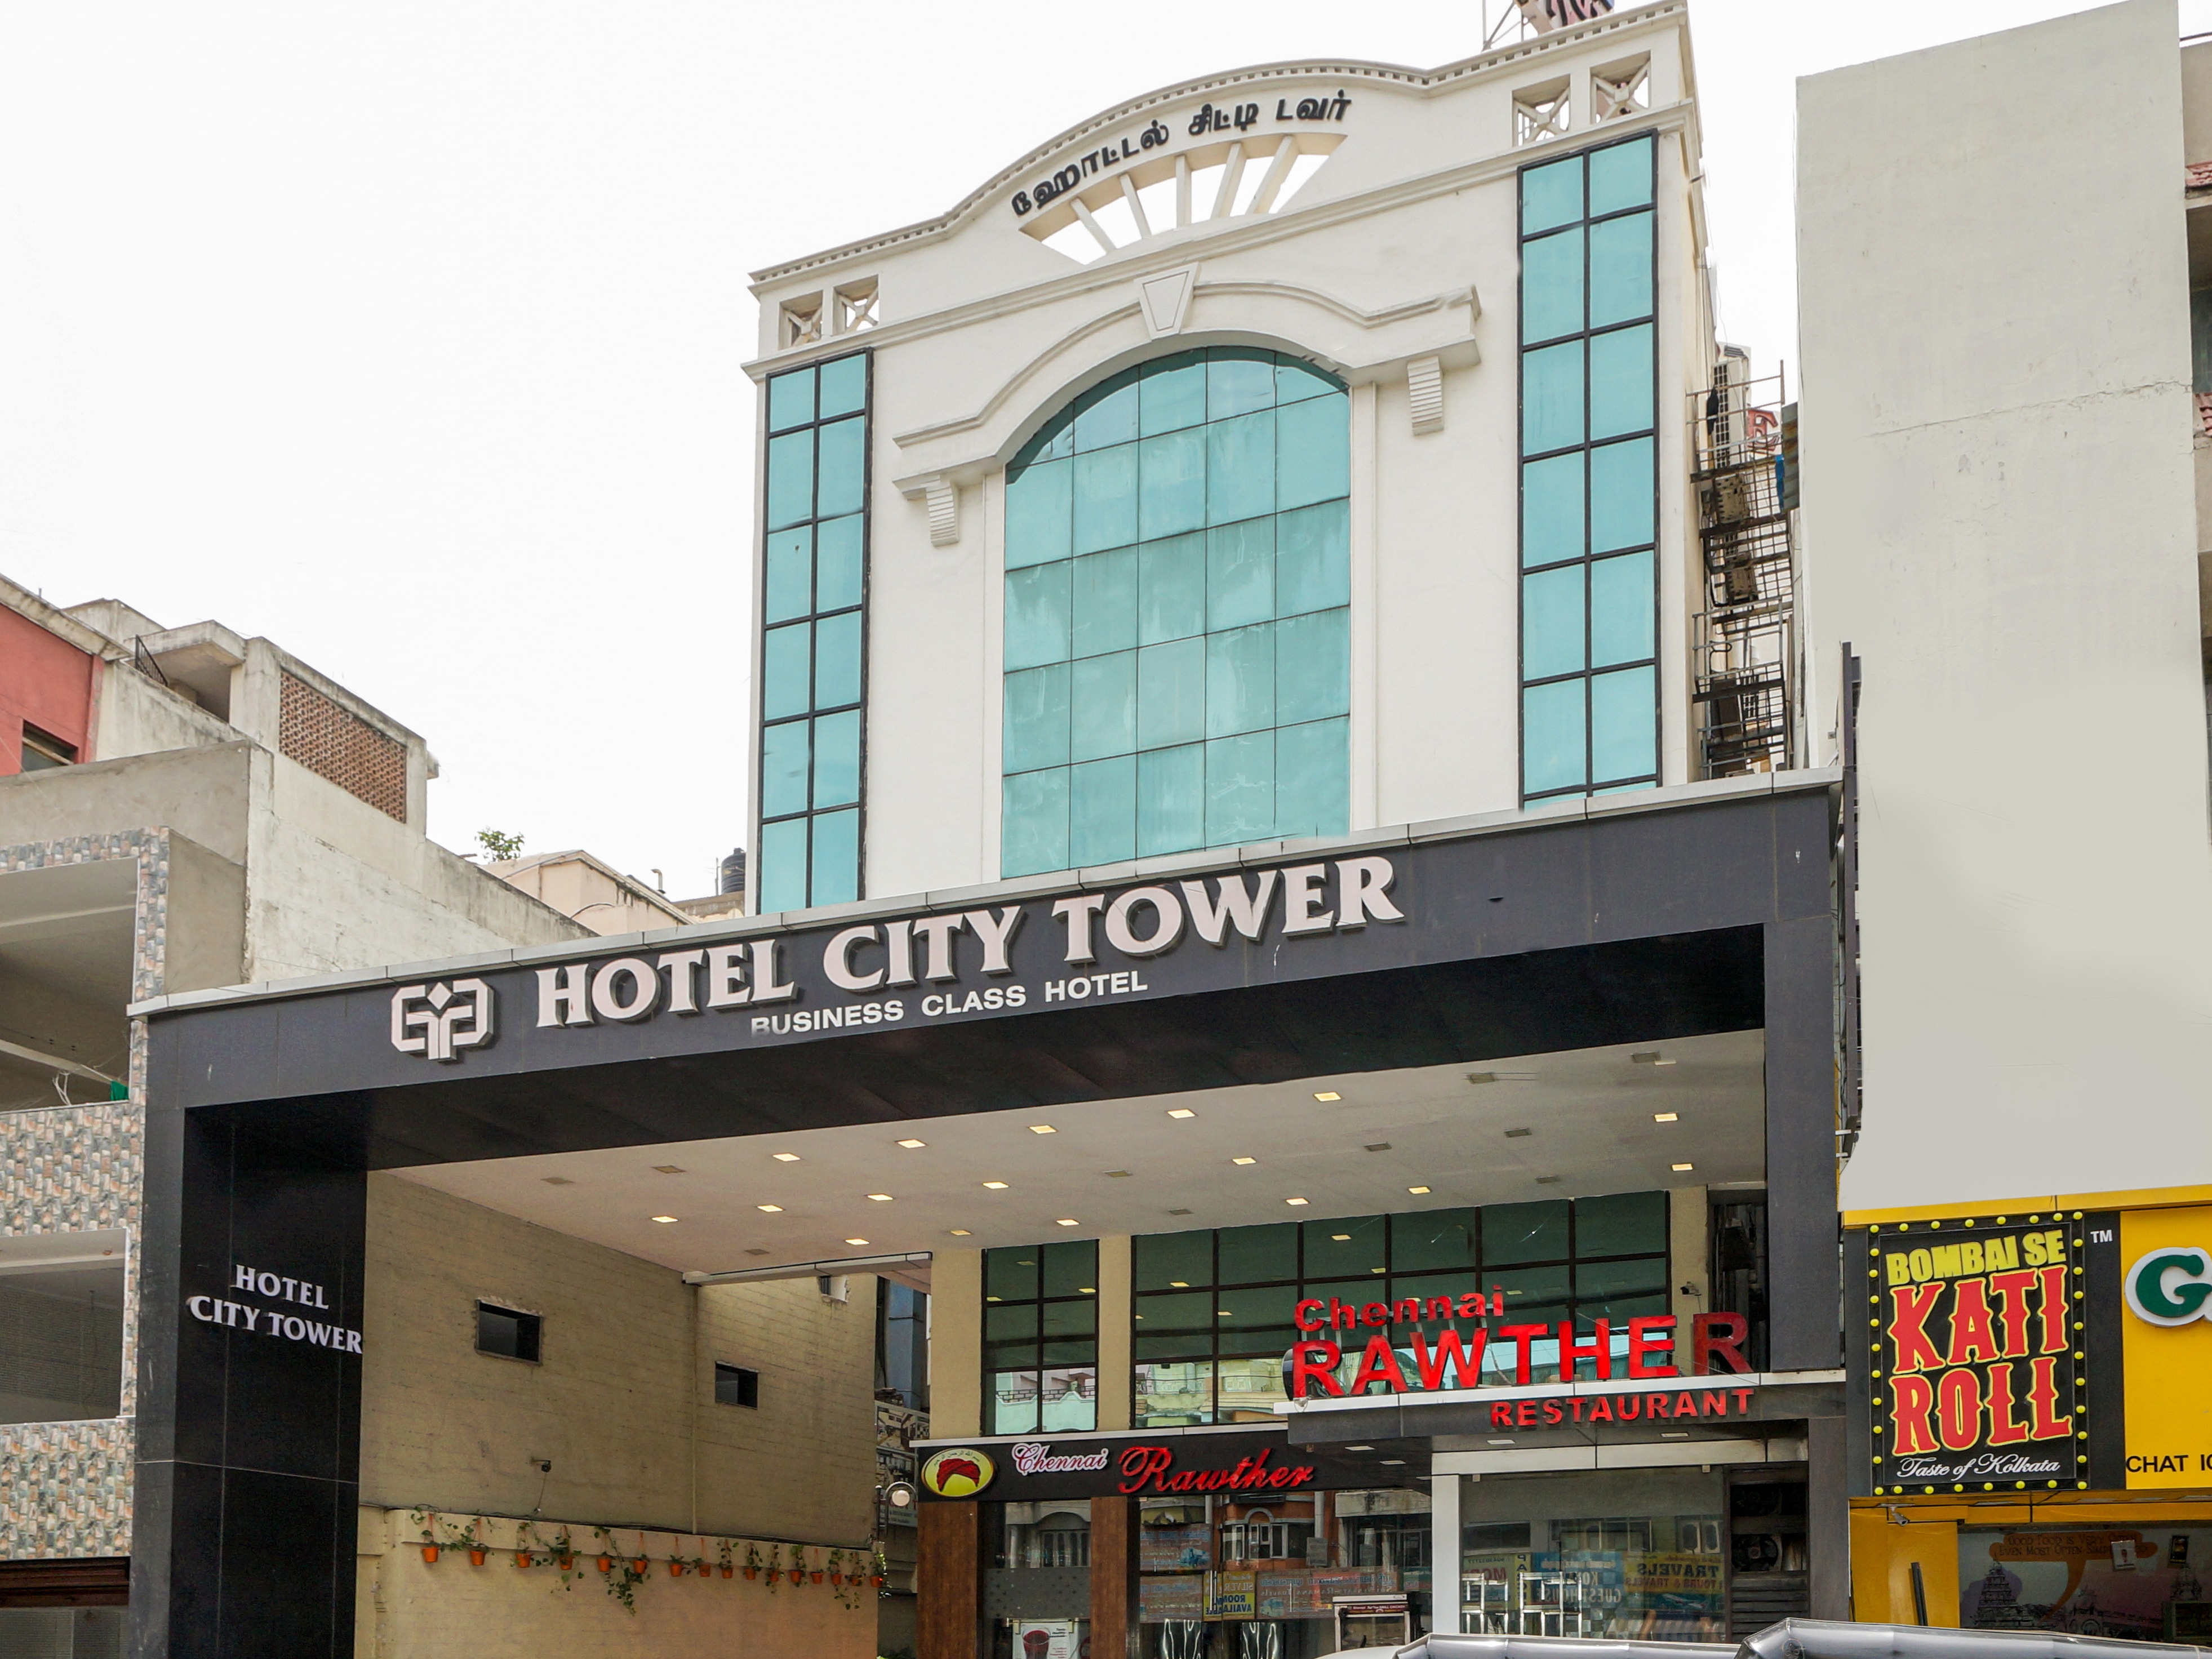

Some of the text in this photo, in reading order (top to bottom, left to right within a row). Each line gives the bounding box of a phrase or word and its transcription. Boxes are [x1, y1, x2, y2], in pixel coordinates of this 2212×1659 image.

[1188, 103, 1259, 135] சிட்டி
[1276, 90, 1352, 121] டவர்
[535, 856, 1407, 1029] HOTEL CITY TOWER
[750, 971, 1148, 1037] BUSINESS CLASS HOTEL
[1886, 1230, 2066, 1286] BOMBAI SE
[2090, 1229, 2113, 1243] TM
[233, 1264, 329, 1310] HOTEL
[1295, 1284, 1504, 1331] Chennai
[188, 1296, 362, 1354] CITY TOWER
[1887, 1265, 2069, 1375] KATI
[1292, 1311, 1754, 1399] RAWTHER
[1491, 1389, 1754, 1428] RESTAURANT
[1889, 1356, 2073, 1456] ROLL
[1012, 1443, 1314, 1494] Chennai Rawther
[1896, 1453, 2060, 1481] Taste of Kolkata
[2126, 1455, 2189, 1473] CHAT
